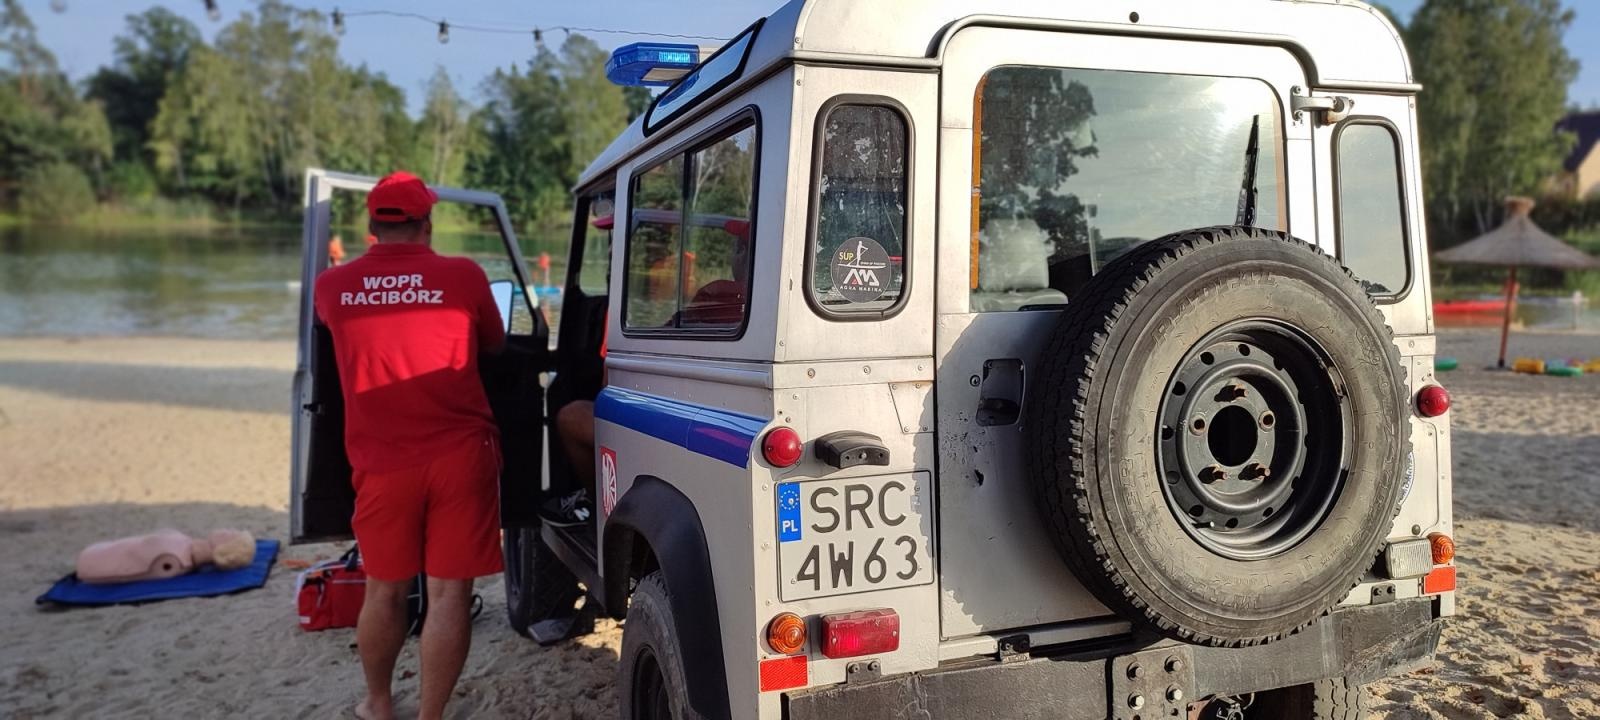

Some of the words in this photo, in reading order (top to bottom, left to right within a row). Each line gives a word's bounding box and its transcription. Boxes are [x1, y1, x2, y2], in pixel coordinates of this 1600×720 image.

[839, 252, 854, 261] SUP
[363, 274, 423, 290] WOPR
[341, 288, 444, 305] RACIBÓRZ
[810, 480, 906, 533] SRC
[782, 520, 798, 533] PL
[796, 535, 918, 591] 4W63
